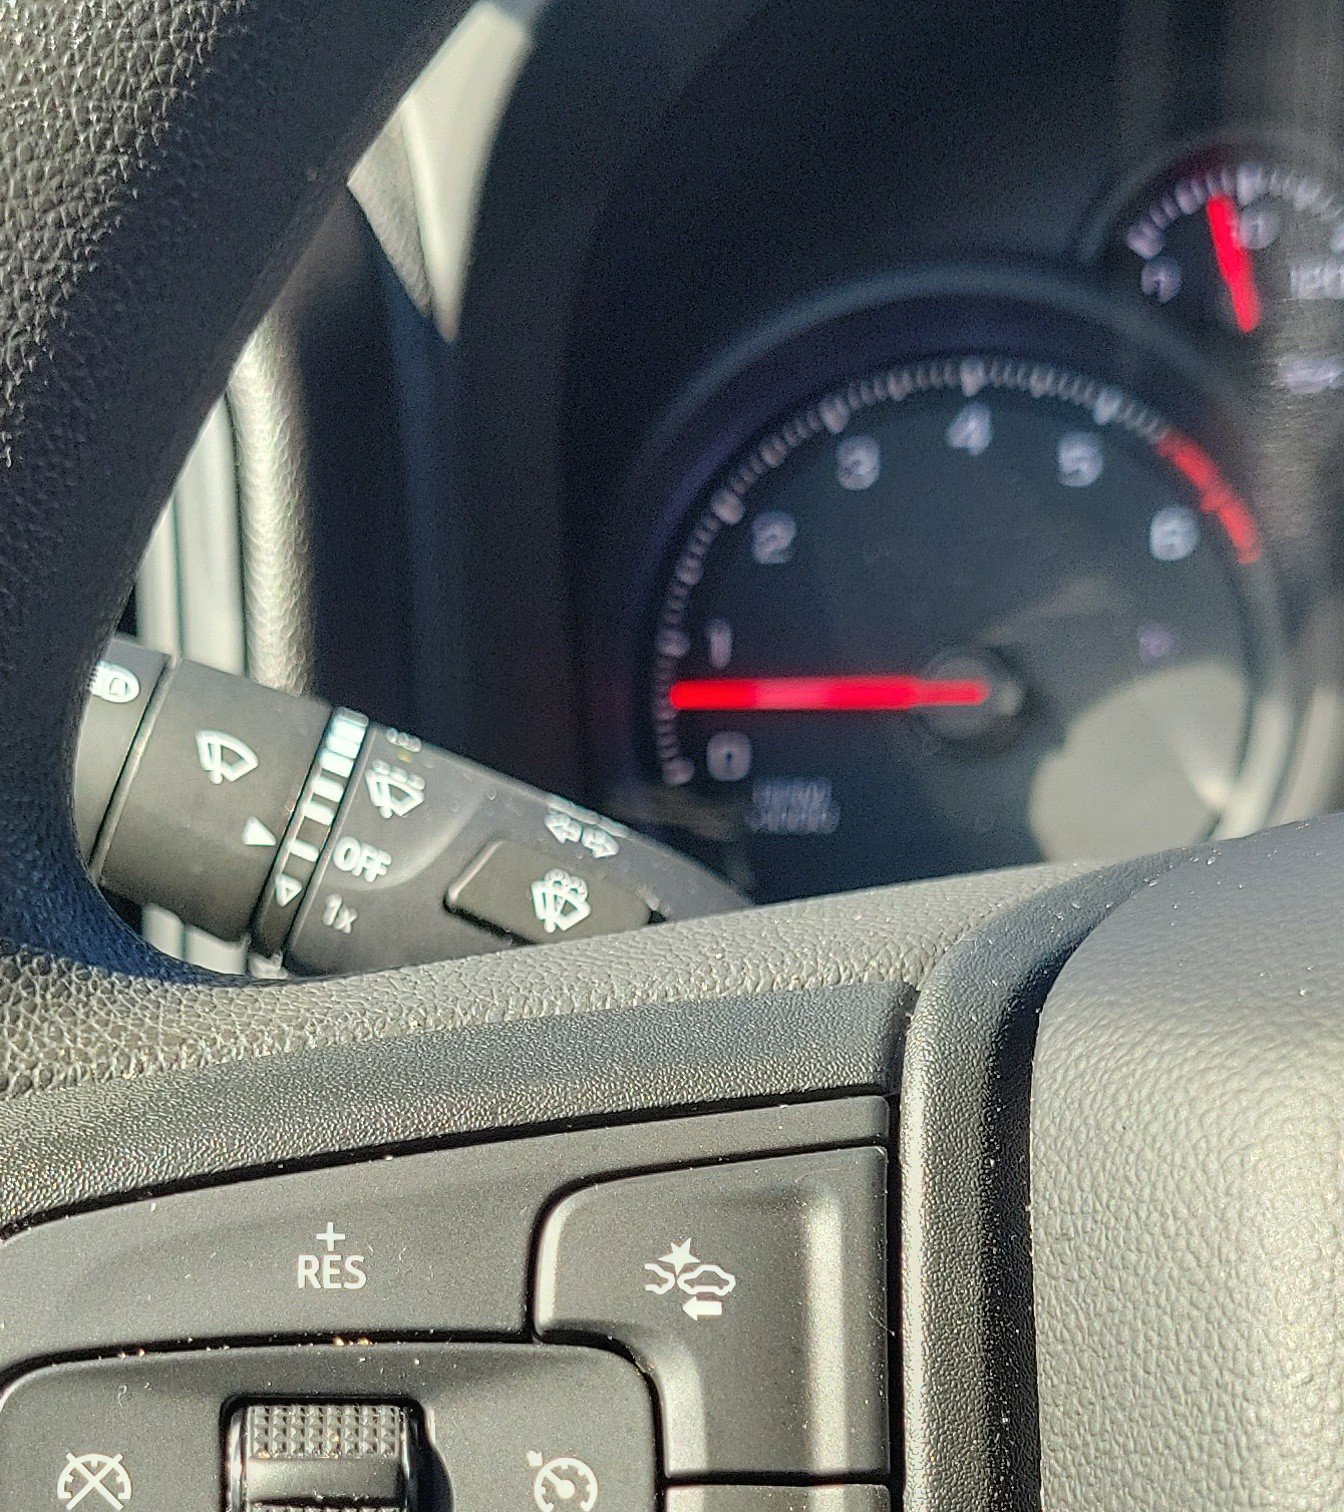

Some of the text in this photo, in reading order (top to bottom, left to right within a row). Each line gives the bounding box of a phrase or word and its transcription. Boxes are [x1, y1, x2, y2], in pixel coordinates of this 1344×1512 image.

[947, 403, 993, 455] 4
[1058, 431, 1104, 487] 5
[706, 730, 753, 783] 0
[333, 836, 392, 882] OFF
[297, 1254, 367, 1291] RES
